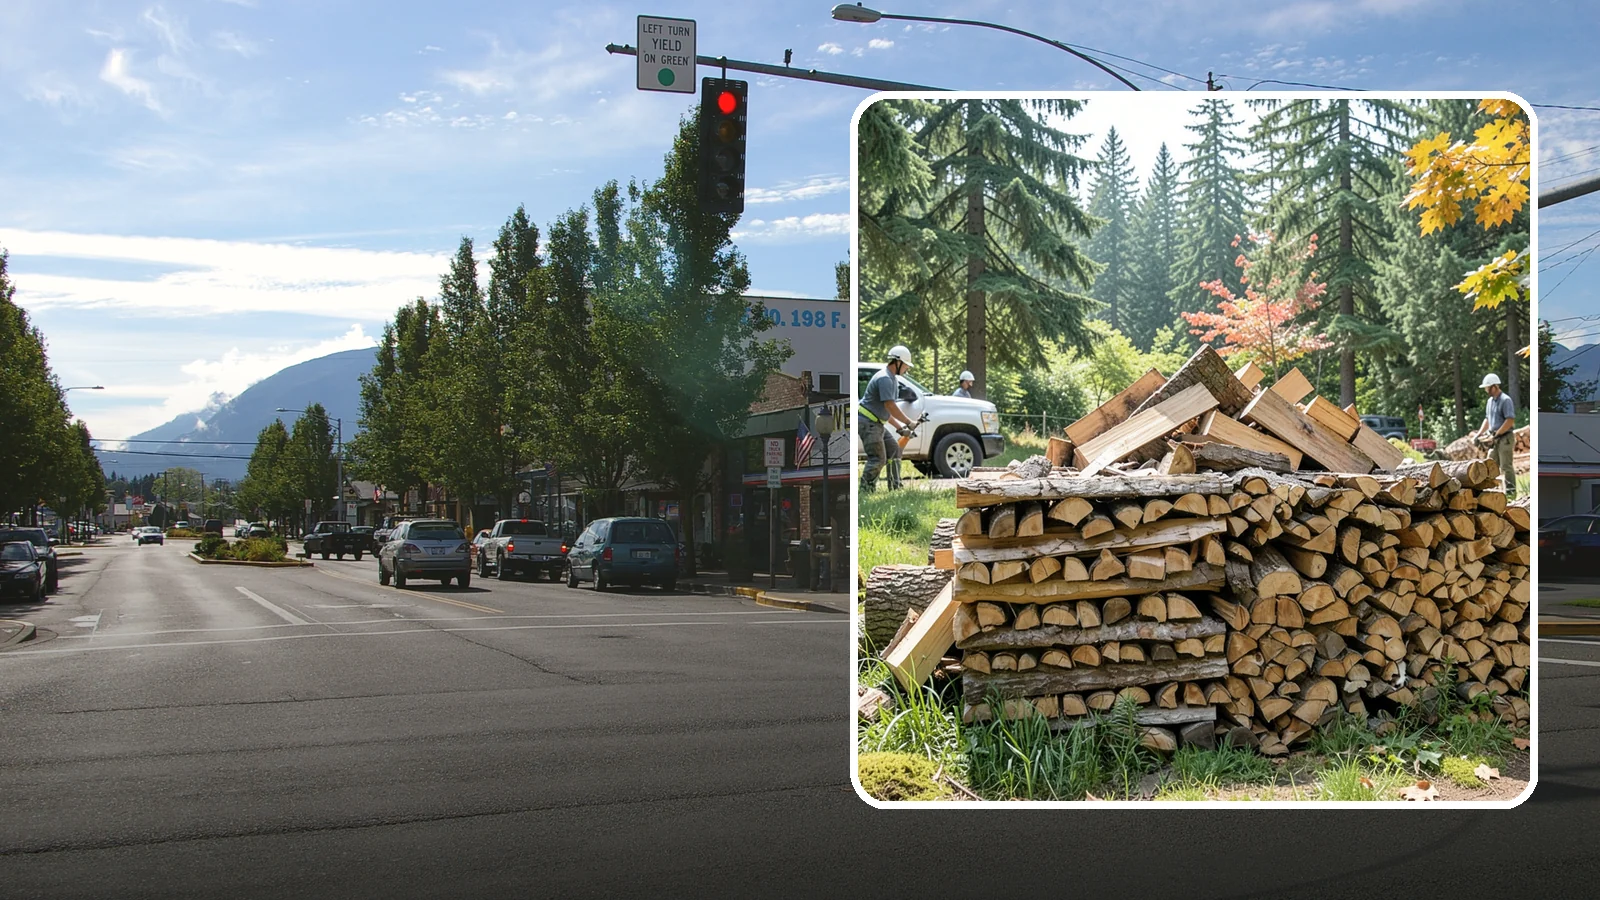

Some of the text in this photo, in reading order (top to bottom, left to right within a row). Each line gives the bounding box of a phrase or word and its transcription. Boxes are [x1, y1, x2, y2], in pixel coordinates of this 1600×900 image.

[643, 23, 690, 36] LEFT TURN
[652, 38, 682, 52] YIELD
[644, 53, 689, 66] ON GREEN
[791, 309, 826, 328] 198
[831, 311, 847, 329] F.
